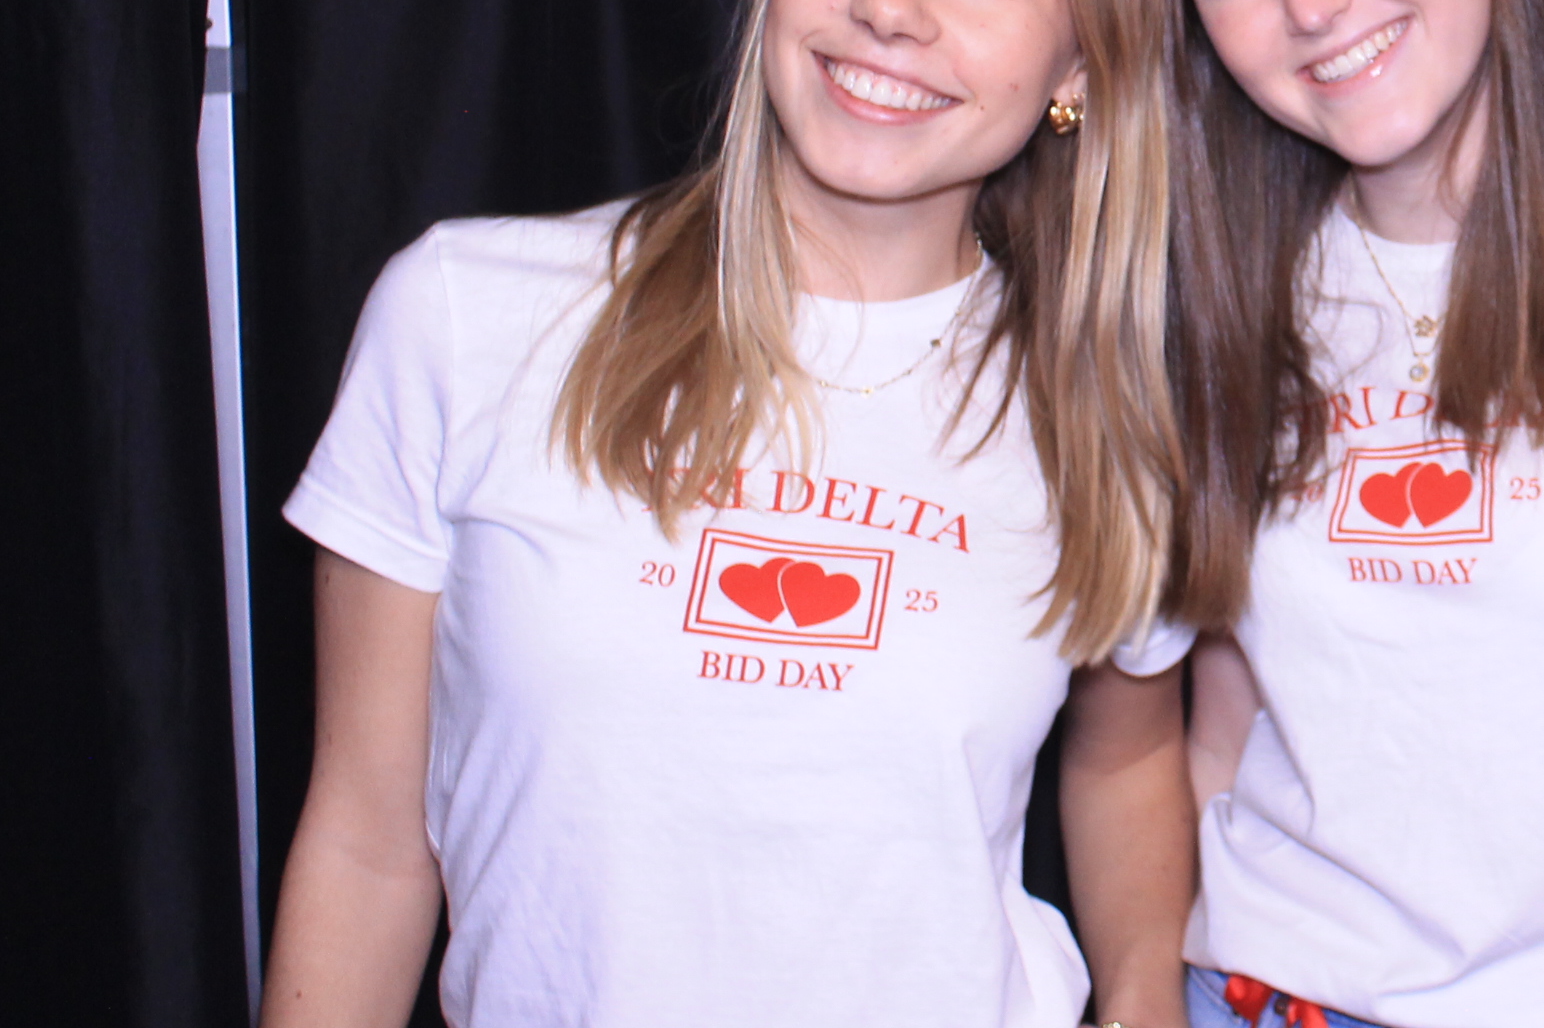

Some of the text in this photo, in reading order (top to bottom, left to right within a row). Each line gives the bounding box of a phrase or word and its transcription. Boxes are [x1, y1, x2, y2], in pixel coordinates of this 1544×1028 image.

[1509, 476, 1542, 501] 25
[767, 470, 971, 553] DELTA
[639, 560, 677, 588] 20
[1347, 556, 1478, 586] BID DAY
[904, 588, 940, 614] 25
[697, 650, 855, 692] BID DAY
